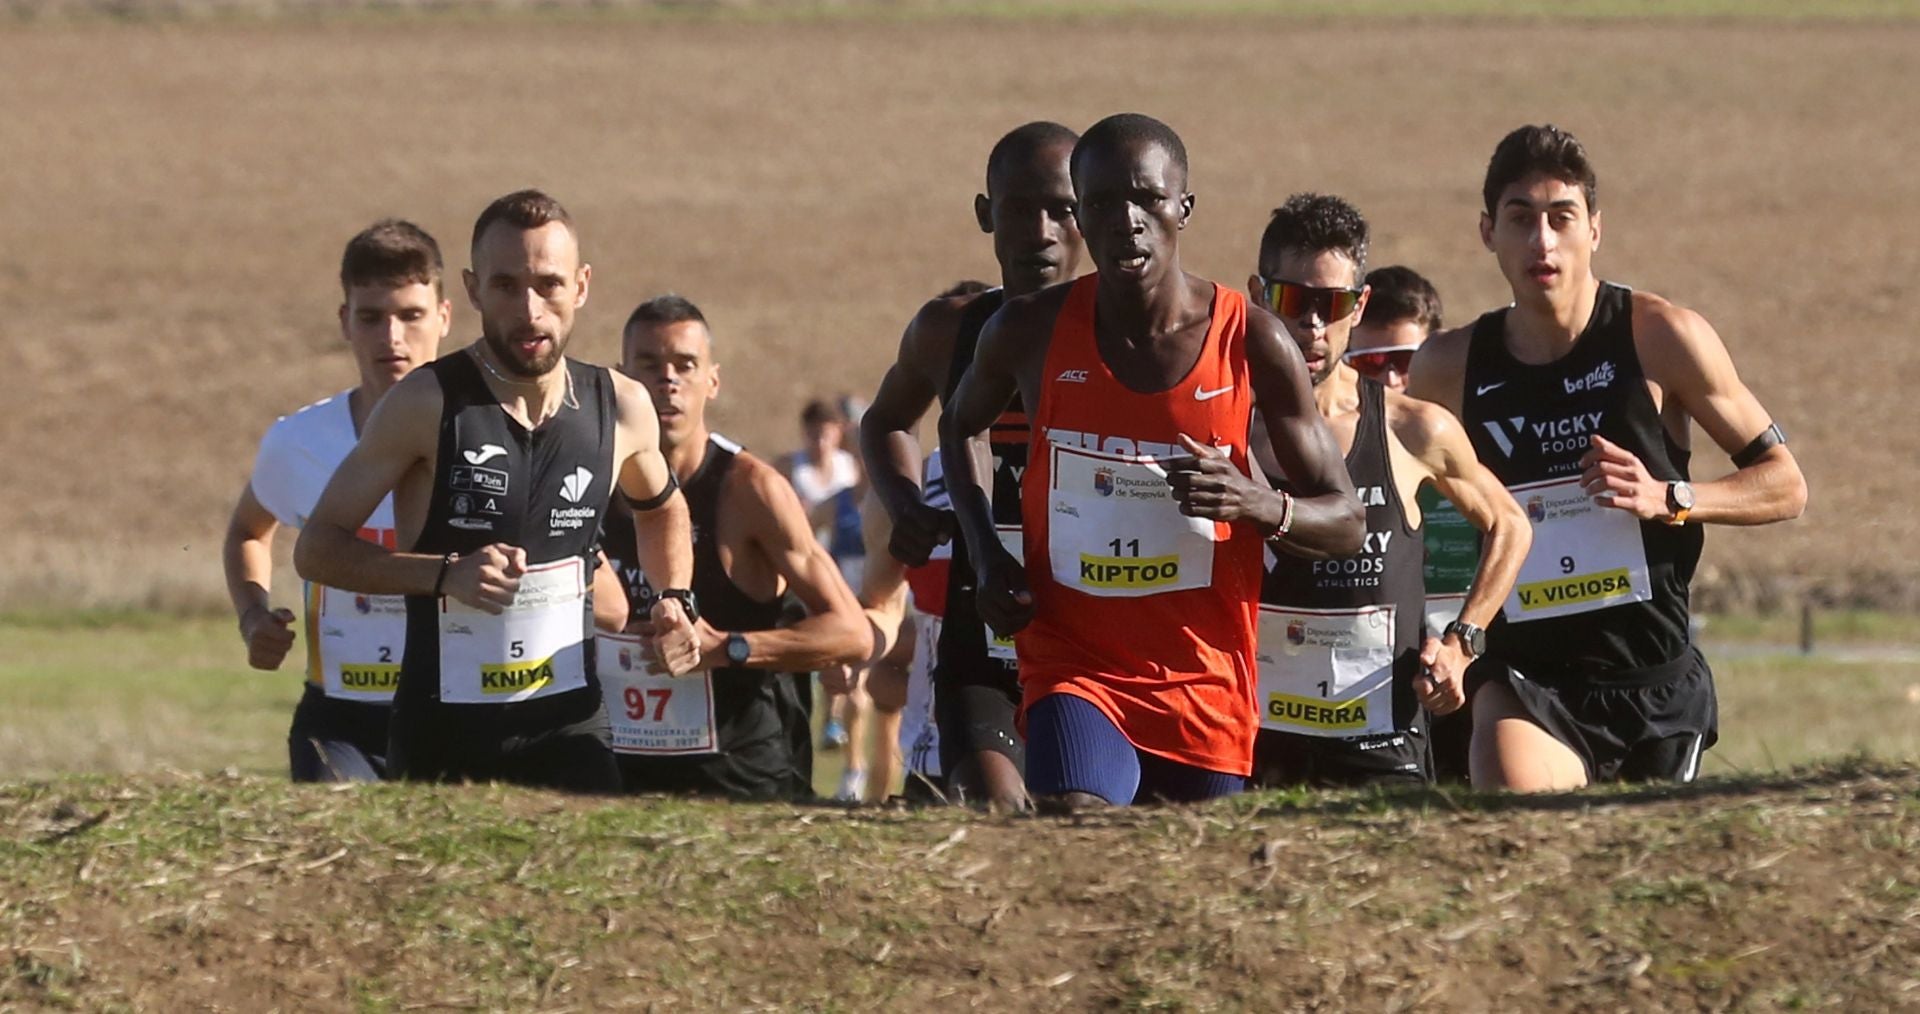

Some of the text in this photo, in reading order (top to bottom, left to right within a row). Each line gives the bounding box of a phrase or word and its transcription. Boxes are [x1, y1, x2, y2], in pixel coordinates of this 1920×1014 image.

[1057, 370, 1089, 383] ACC
[1532, 411, 1602, 438] VICKY
[1541, 436, 1588, 454] FOOD
[1548, 461, 1577, 473] ATHLE
[1115, 476, 1166, 488] Diputación
[1115, 489, 1166, 500] de Segovia
[551, 507, 596, 519] Fundación
[1547, 504, 1592, 520] de Segovia
[550, 518, 583, 529] Unicaja
[1108, 538, 1141, 557] 11
[1081, 562, 1178, 582] KIPTOO
[1313, 557, 1384, 575] FOODS
[1560, 556, 1575, 574] 9
[1316, 577, 1380, 587] ATHLETICS
[1519, 574, 1631, 607] V. VICIOSA
[379, 646, 392, 662] 2
[511, 641, 524, 658] 5
[482, 665, 554, 689] KNIYA
[1317, 681, 1328, 698] 1
[624, 688, 672, 722] 97
[1269, 700, 1367, 723] GUERRA
